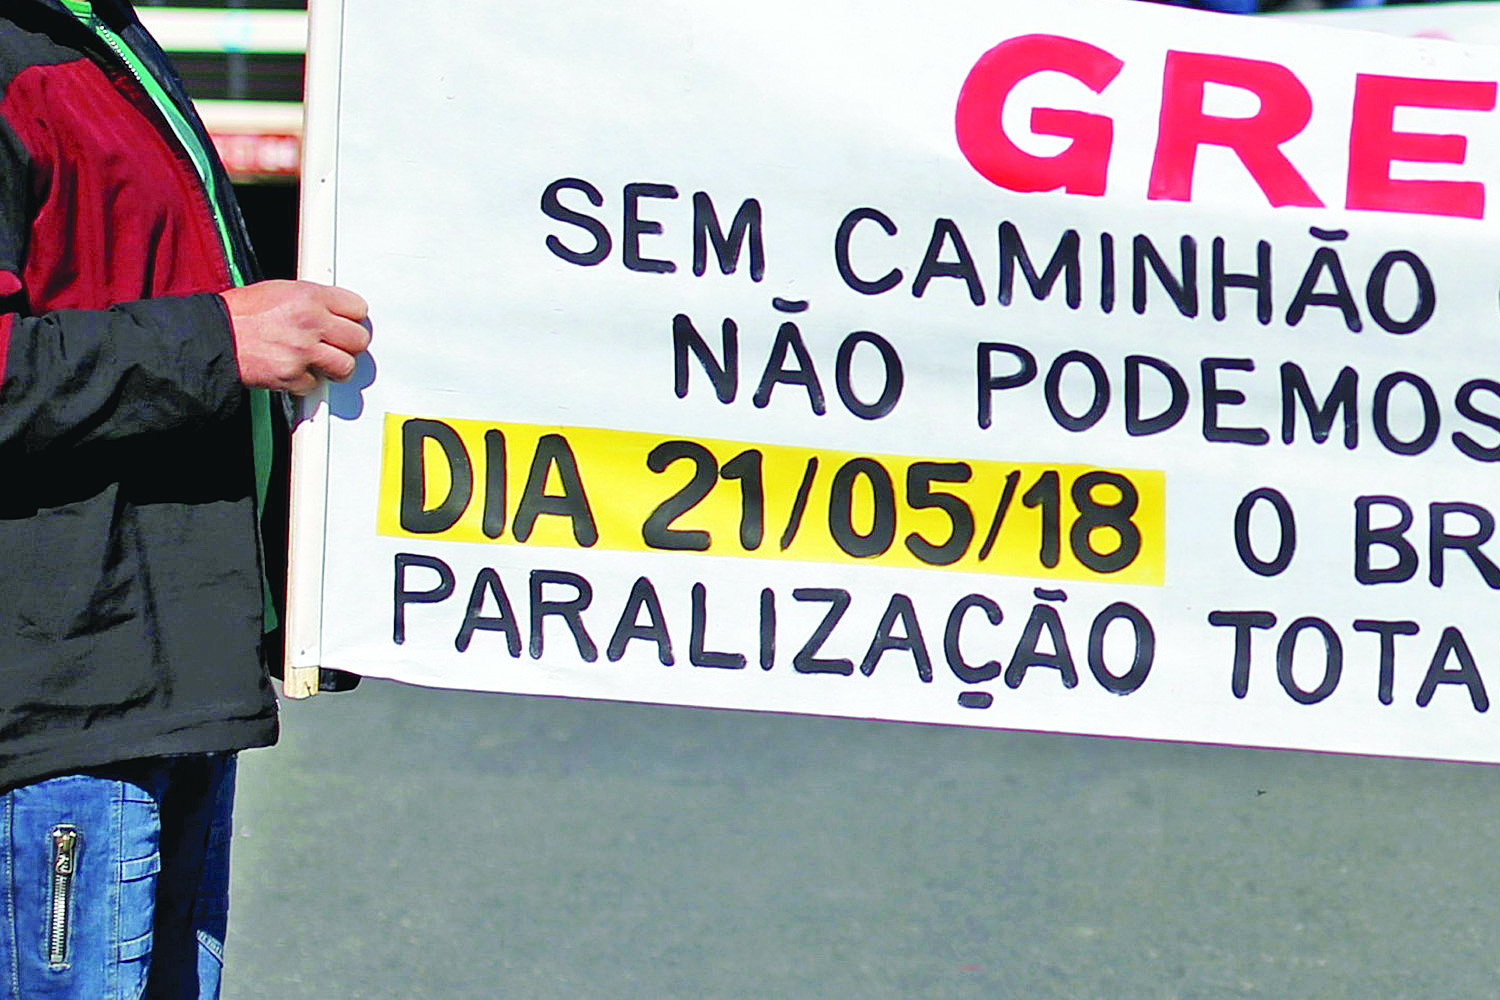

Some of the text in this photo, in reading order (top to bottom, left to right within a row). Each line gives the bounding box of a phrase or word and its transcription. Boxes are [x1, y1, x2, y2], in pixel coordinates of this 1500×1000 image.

[540, 177, 765, 283] SEM
[834, 207, 1436, 335] CAMINHÃO
[672, 297, 904, 421] NÃO
[399, 417, 599, 548] DIA
[641, 440, 1142, 574] 21/05/18
[1234, 487, 1296, 577] O
[392, 552, 1156, 709] PARALIZAÇÃO
